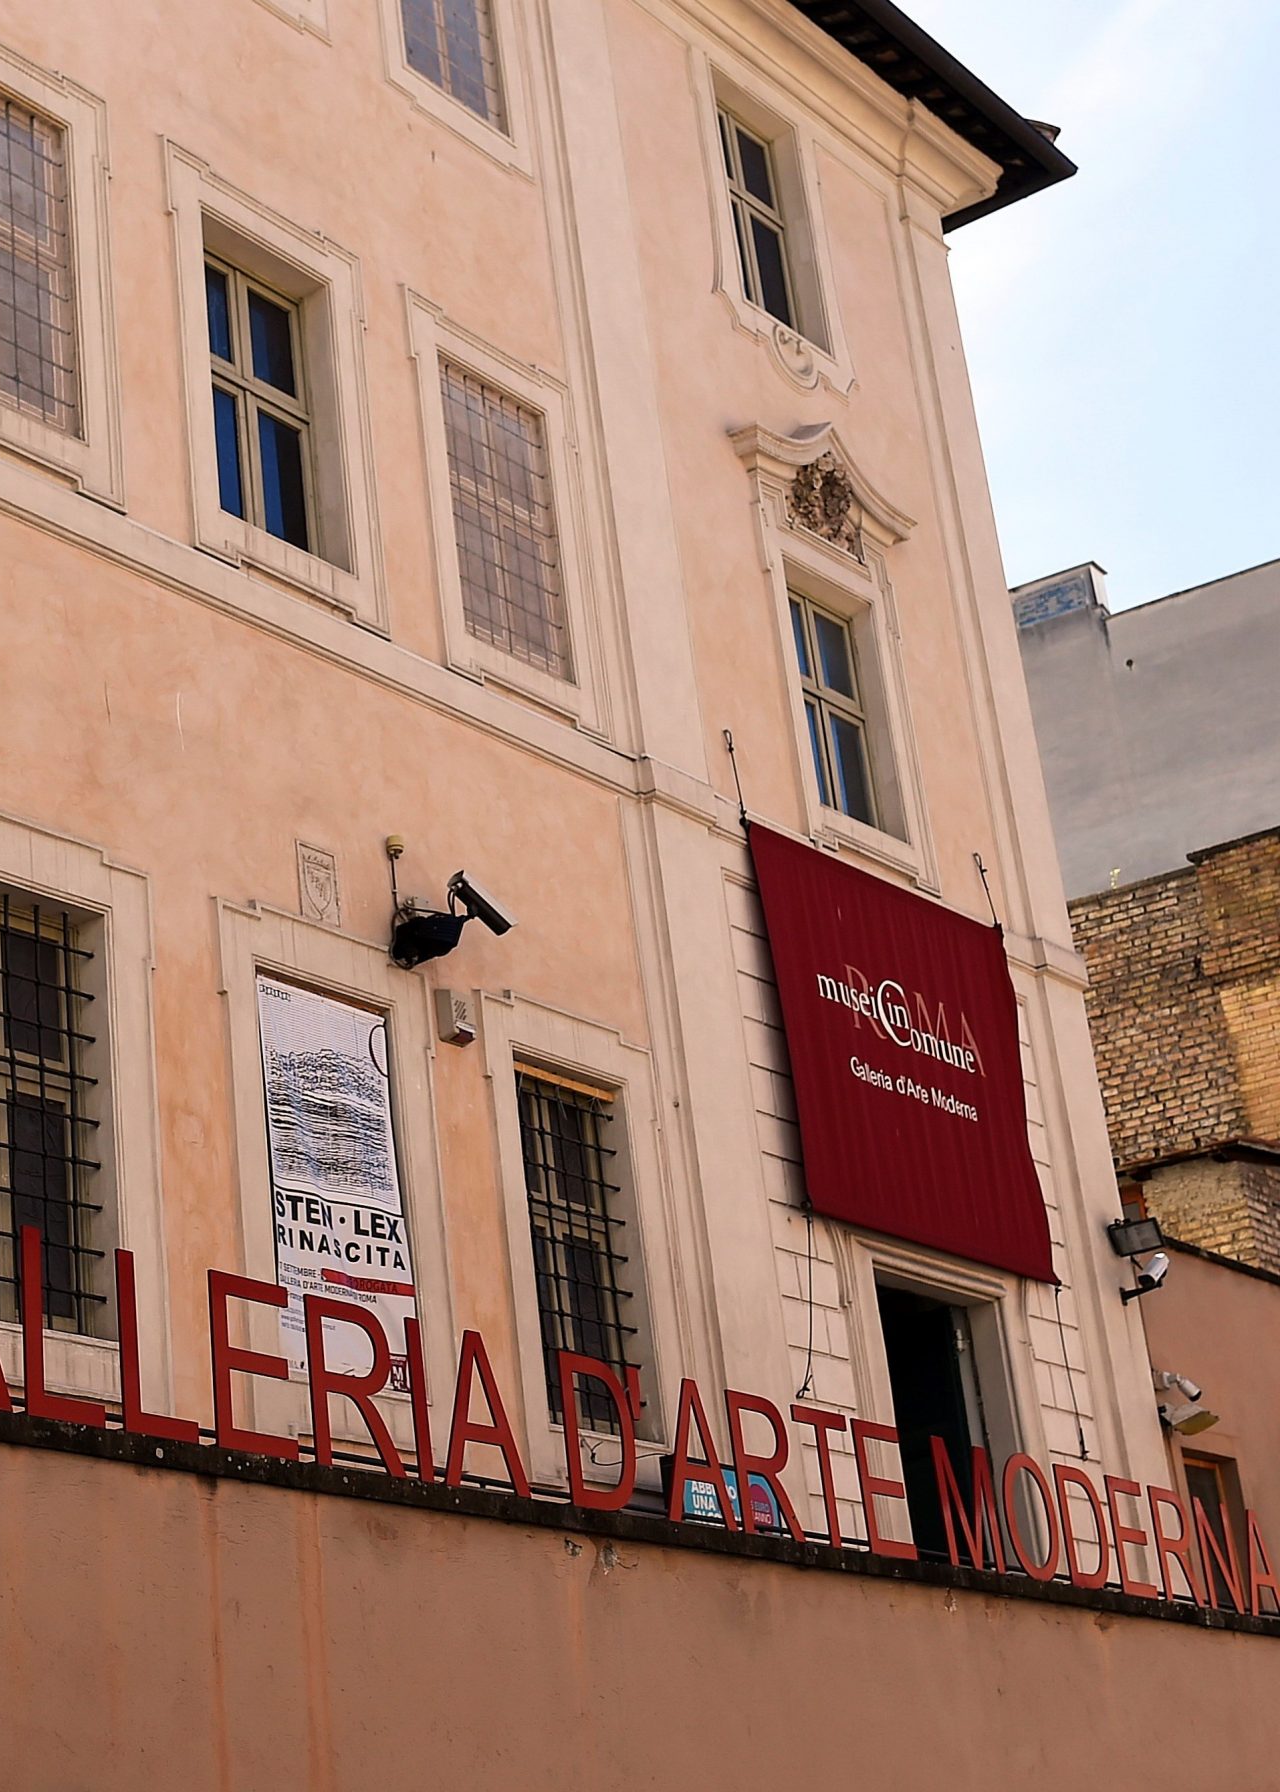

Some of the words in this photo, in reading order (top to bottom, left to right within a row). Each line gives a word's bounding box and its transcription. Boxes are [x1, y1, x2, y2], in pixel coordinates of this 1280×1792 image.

[816, 973, 879, 1021] musei
[930, 1086, 978, 1122] Moderna
[276, 1190, 334, 1231] STEN
[354, 1211, 404, 1245] LEX
[277, 1223, 407, 1272] RINASCITA
[556, 1348, 918, 1560] D'ARTE
[930, 1434, 1280, 1616] MODERNA
[692, 1494, 717, 1511] UNA
